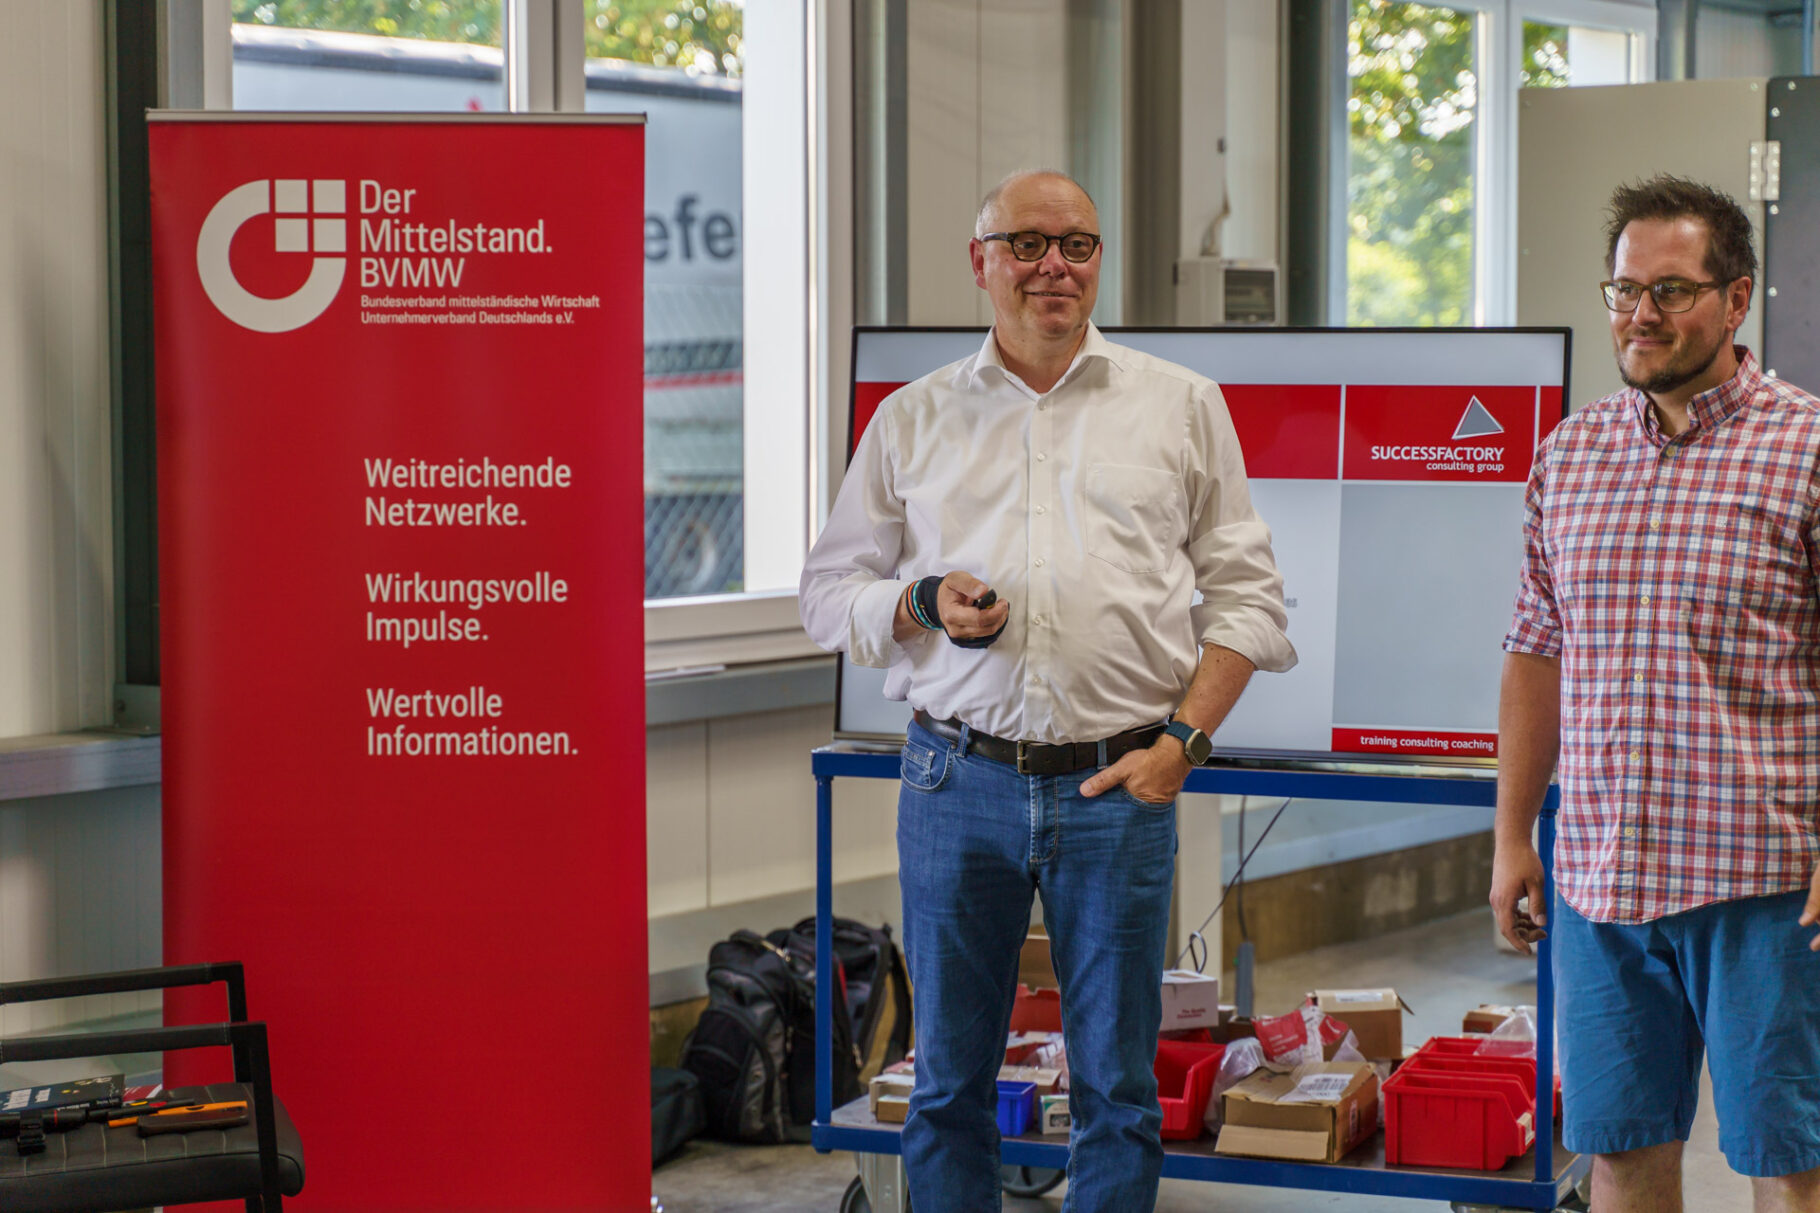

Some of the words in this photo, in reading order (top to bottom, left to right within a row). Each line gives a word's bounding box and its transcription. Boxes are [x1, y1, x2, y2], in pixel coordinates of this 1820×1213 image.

[359, 180, 417, 214] Der
[359, 218, 553, 254] Mittelstand.
[359, 257, 466, 288] BVMW
[360, 294, 447, 308] Bundesverband
[448, 294, 539, 308] mittelständische
[541, 294, 601, 309] Wirtschaft
[360, 310, 477, 325] Unternehmerverband
[478, 310, 553, 325] Deutschlands
[554, 312, 575, 325] e.V.
[1370, 445, 1504, 460] SUCCESSFACTORY
[1426, 461, 1475, 473] consulting
[1477, 462, 1505, 473] group
[364, 456, 572, 488] Weitreichende
[364, 495, 528, 527] Netzwerke.
[365, 571, 569, 610] Wirkungsvolle
[366, 610, 489, 649] Impulse.
[366, 686, 503, 718] Wertvolle
[367, 724, 579, 756] Informationen.
[1360, 735, 1398, 748] training
[1399, 737, 1449, 750] consulting
[1450, 739, 1494, 751] coaching
